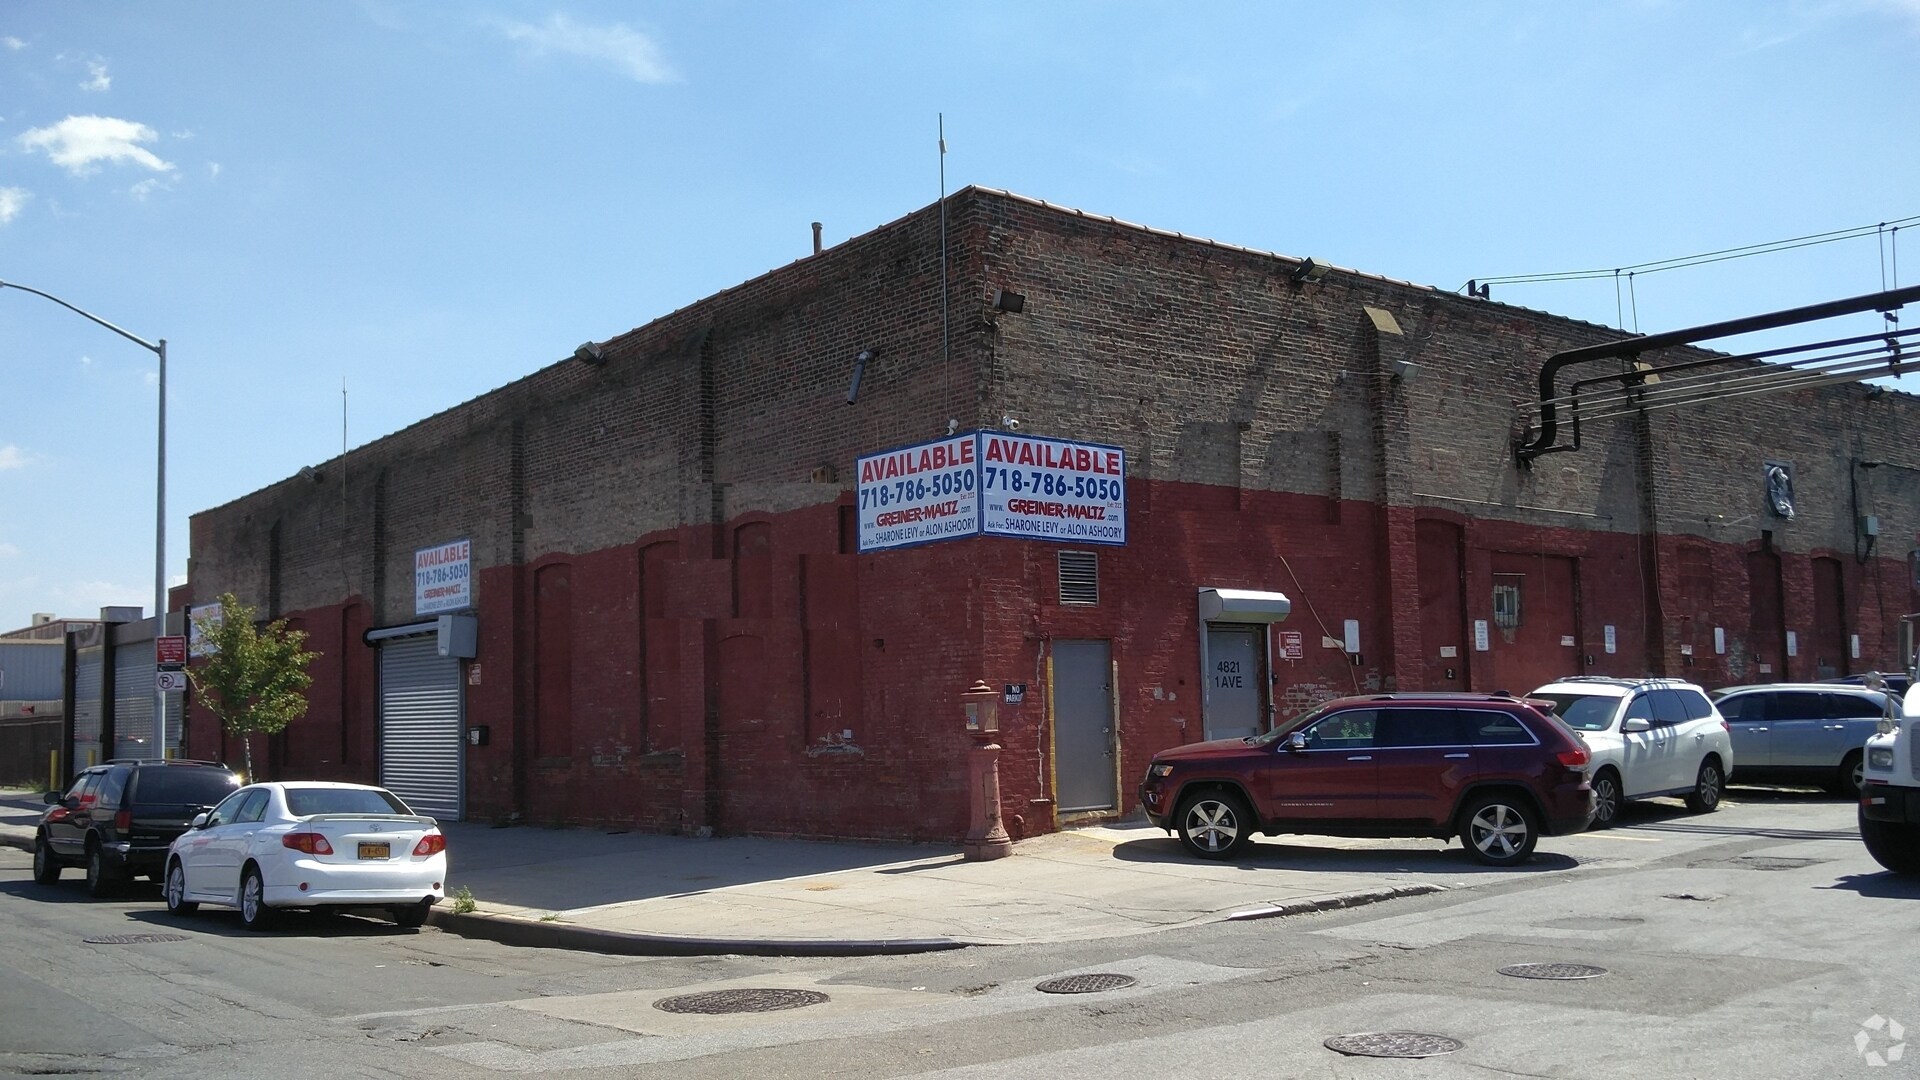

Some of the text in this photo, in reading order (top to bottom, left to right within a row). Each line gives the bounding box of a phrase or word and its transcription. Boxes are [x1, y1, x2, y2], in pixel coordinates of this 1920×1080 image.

[861, 440, 974, 484] AVAILABLE
[985, 438, 1121, 476] AVAILABLE
[861, 469, 975, 510] 718-786-5050
[985, 467, 1121, 501] 718-786-5050
[876, 500, 959, 528] GREINER-MALTZ
[989, 503, 1005, 512] www.
[1007, 498, 1106, 520] GREINER-MALTZ
[875, 528, 903, 544] SHARONE
[904, 526, 919, 539] LEVY
[925, 522, 943, 536] ALON
[944, 517, 975, 533] ASHOORY
[987, 521, 995, 529] Ask
[996, 521, 1005, 529] For:
[1005, 517, 1041, 532] SHARONE
[1042, 521, 1059, 534] LEVY
[1067, 524, 1088, 535] ALON
[1089, 526, 1122, 538] ASHOORY
[417, 543, 469, 569] AVAILABLE
[417, 563, 469, 587] 718-786-5050
[1217, 661, 1240, 673] 4821
[1588, 655, 1593, 665] 3
[1215, 676, 1243, 688] 1 AVE
[1447, 668, 1453, 678] 2
[1011, 685, 1020, 694] NO
